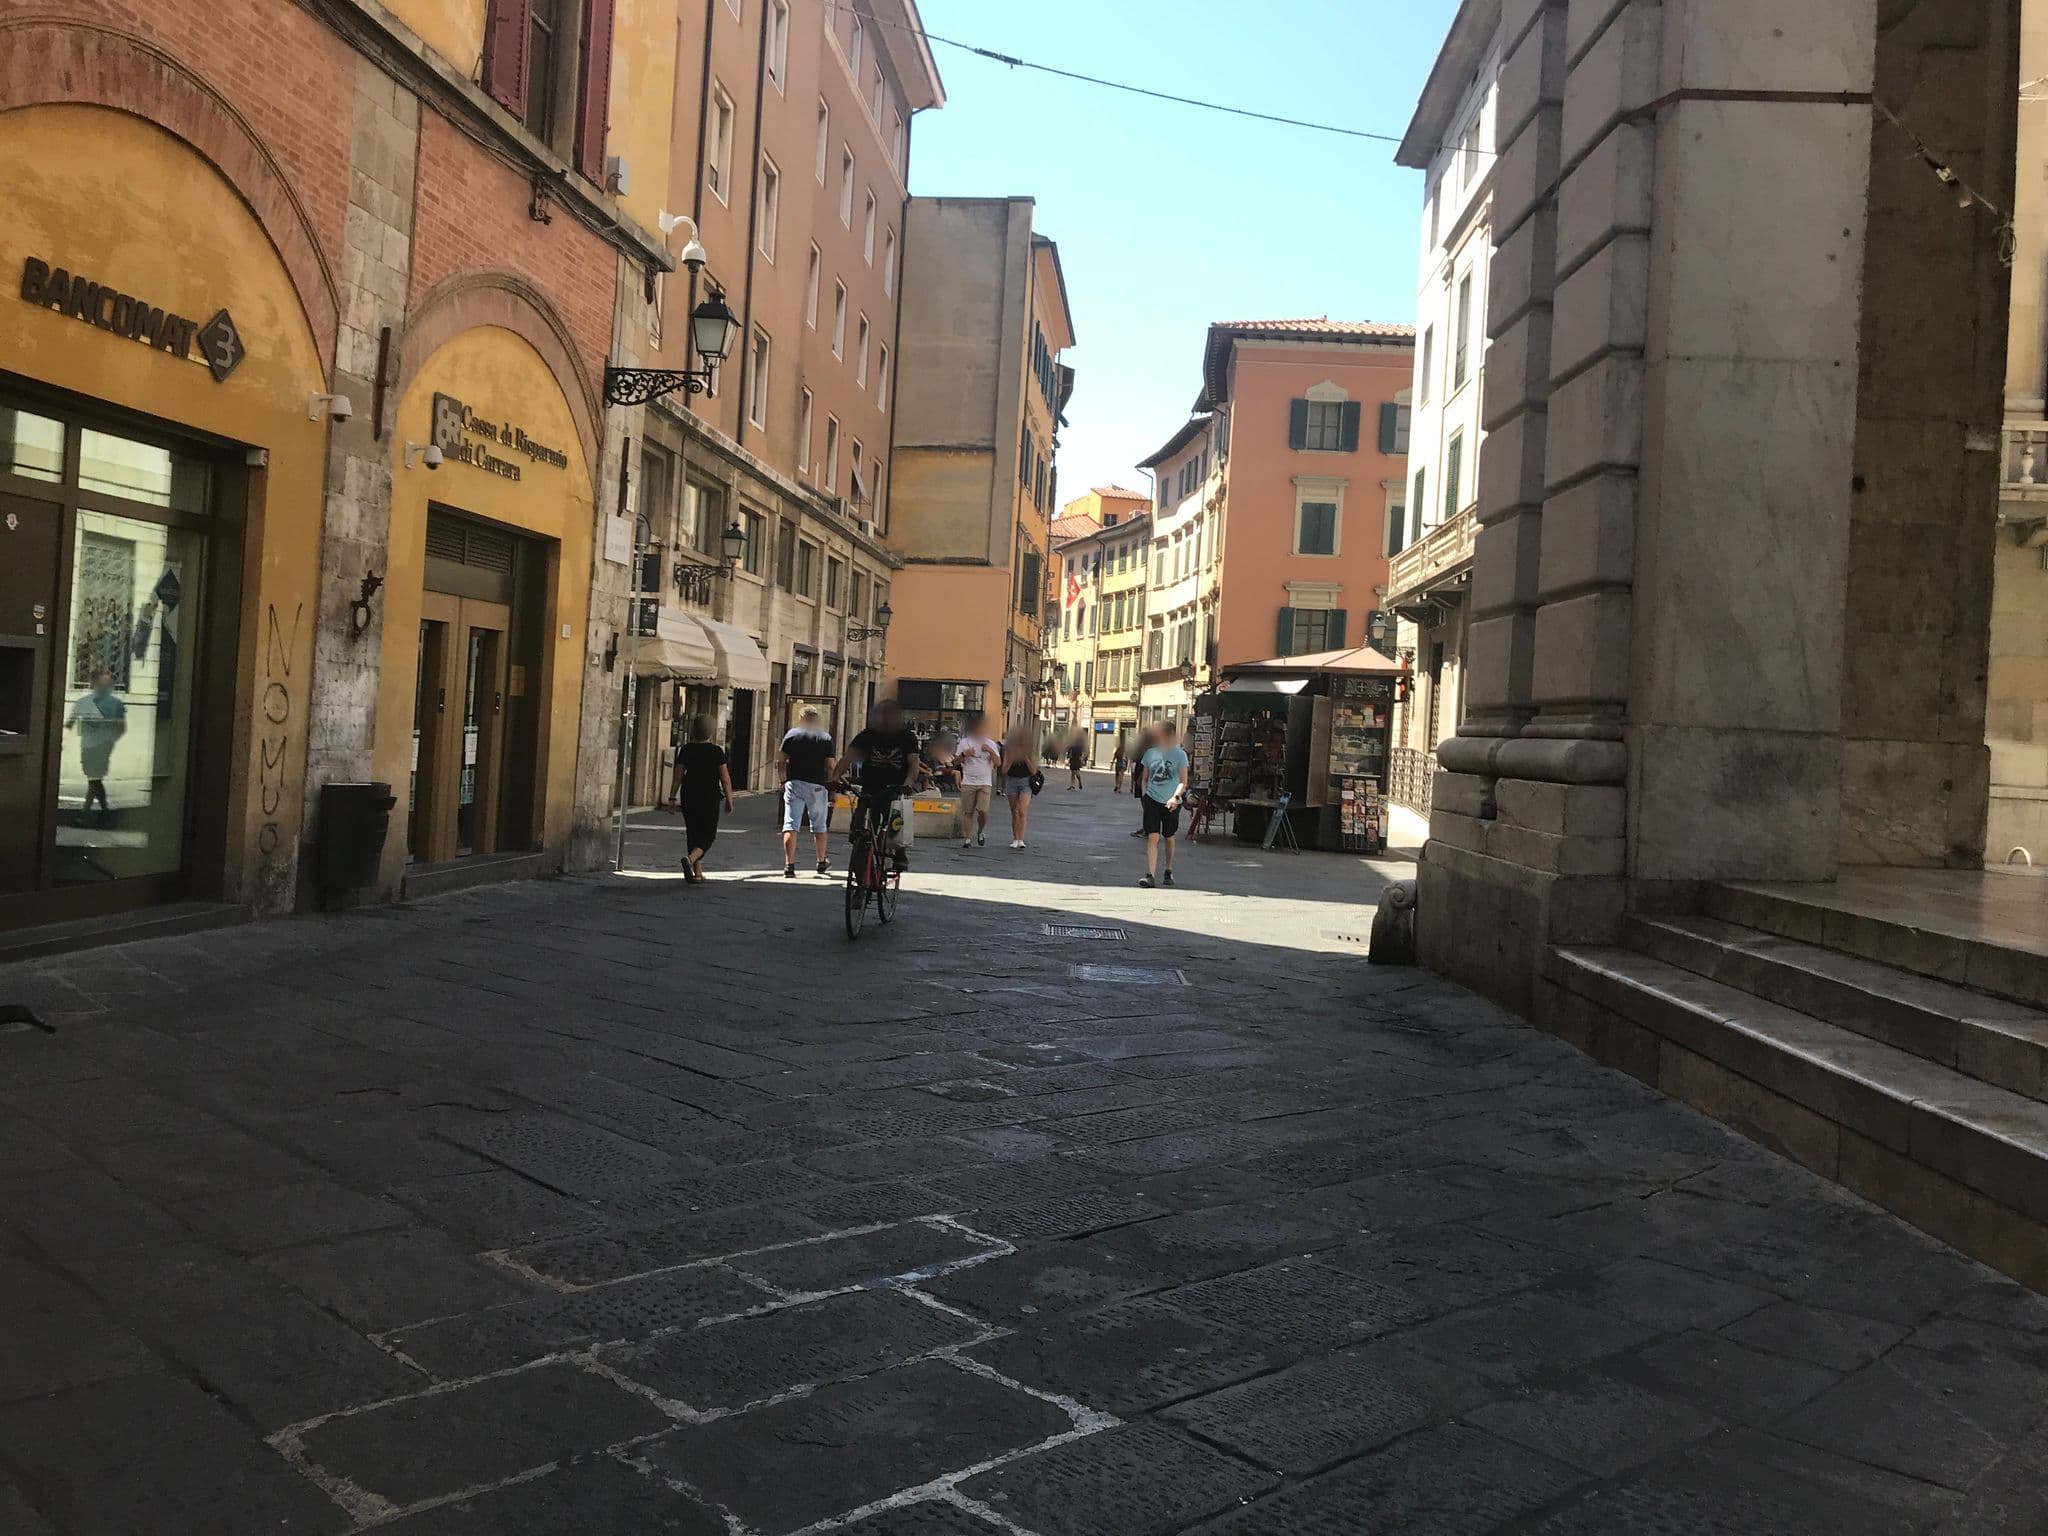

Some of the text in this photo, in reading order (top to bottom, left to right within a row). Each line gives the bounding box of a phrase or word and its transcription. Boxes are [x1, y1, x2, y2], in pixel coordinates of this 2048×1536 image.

[21, 256, 198, 360] BANCOMAT
[460, 438, 520, 481] di Carrara
[461, 405, 497, 441] Cassa
[501, 422, 512, 447] di
[515, 427, 567, 470] Risparmio
